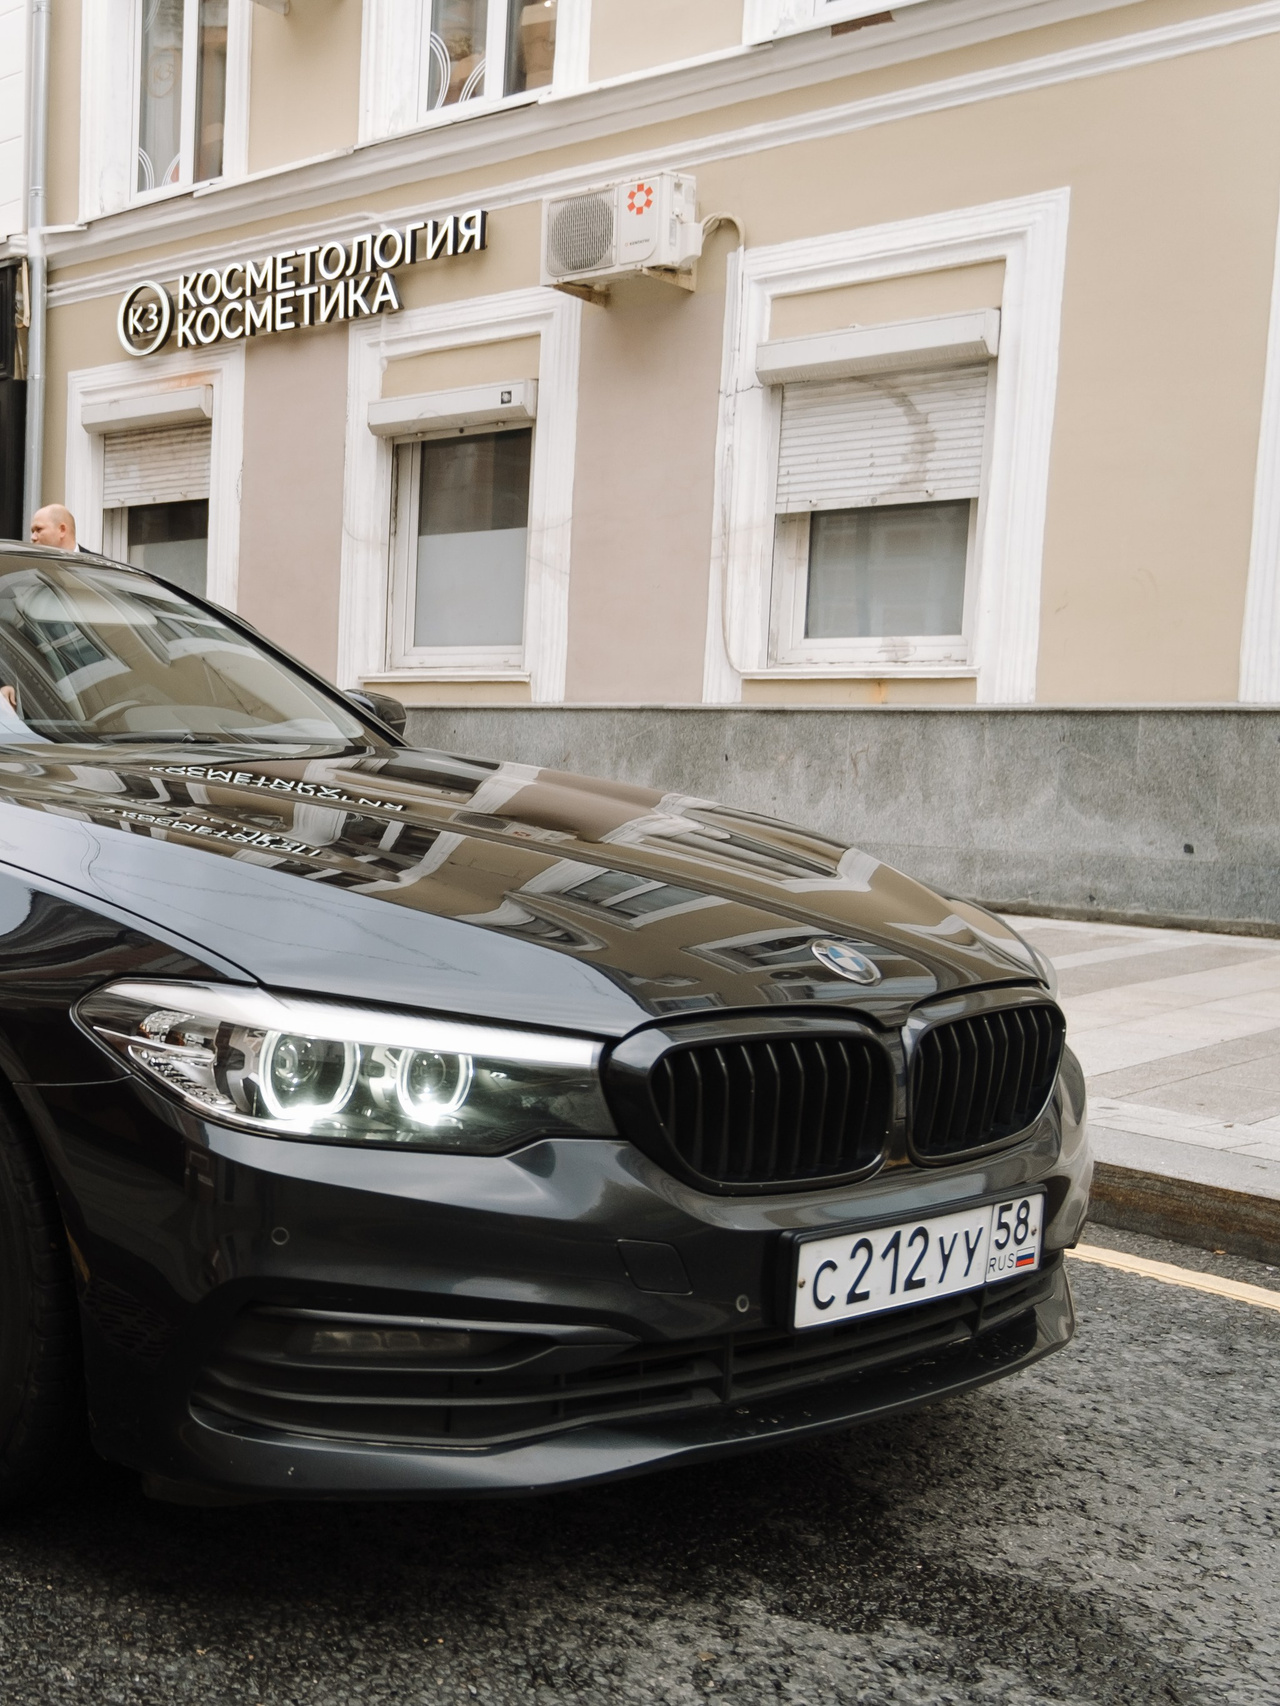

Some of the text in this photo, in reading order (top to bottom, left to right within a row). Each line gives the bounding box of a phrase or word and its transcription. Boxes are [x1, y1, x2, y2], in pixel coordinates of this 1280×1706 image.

[177, 209, 487, 310] КОСМЕТОЛОГИЯ
[177, 272, 400, 347] КОСМЕТИКА
[994, 1200, 1031, 1250] 58
[988, 1252, 1015, 1274] RUS
